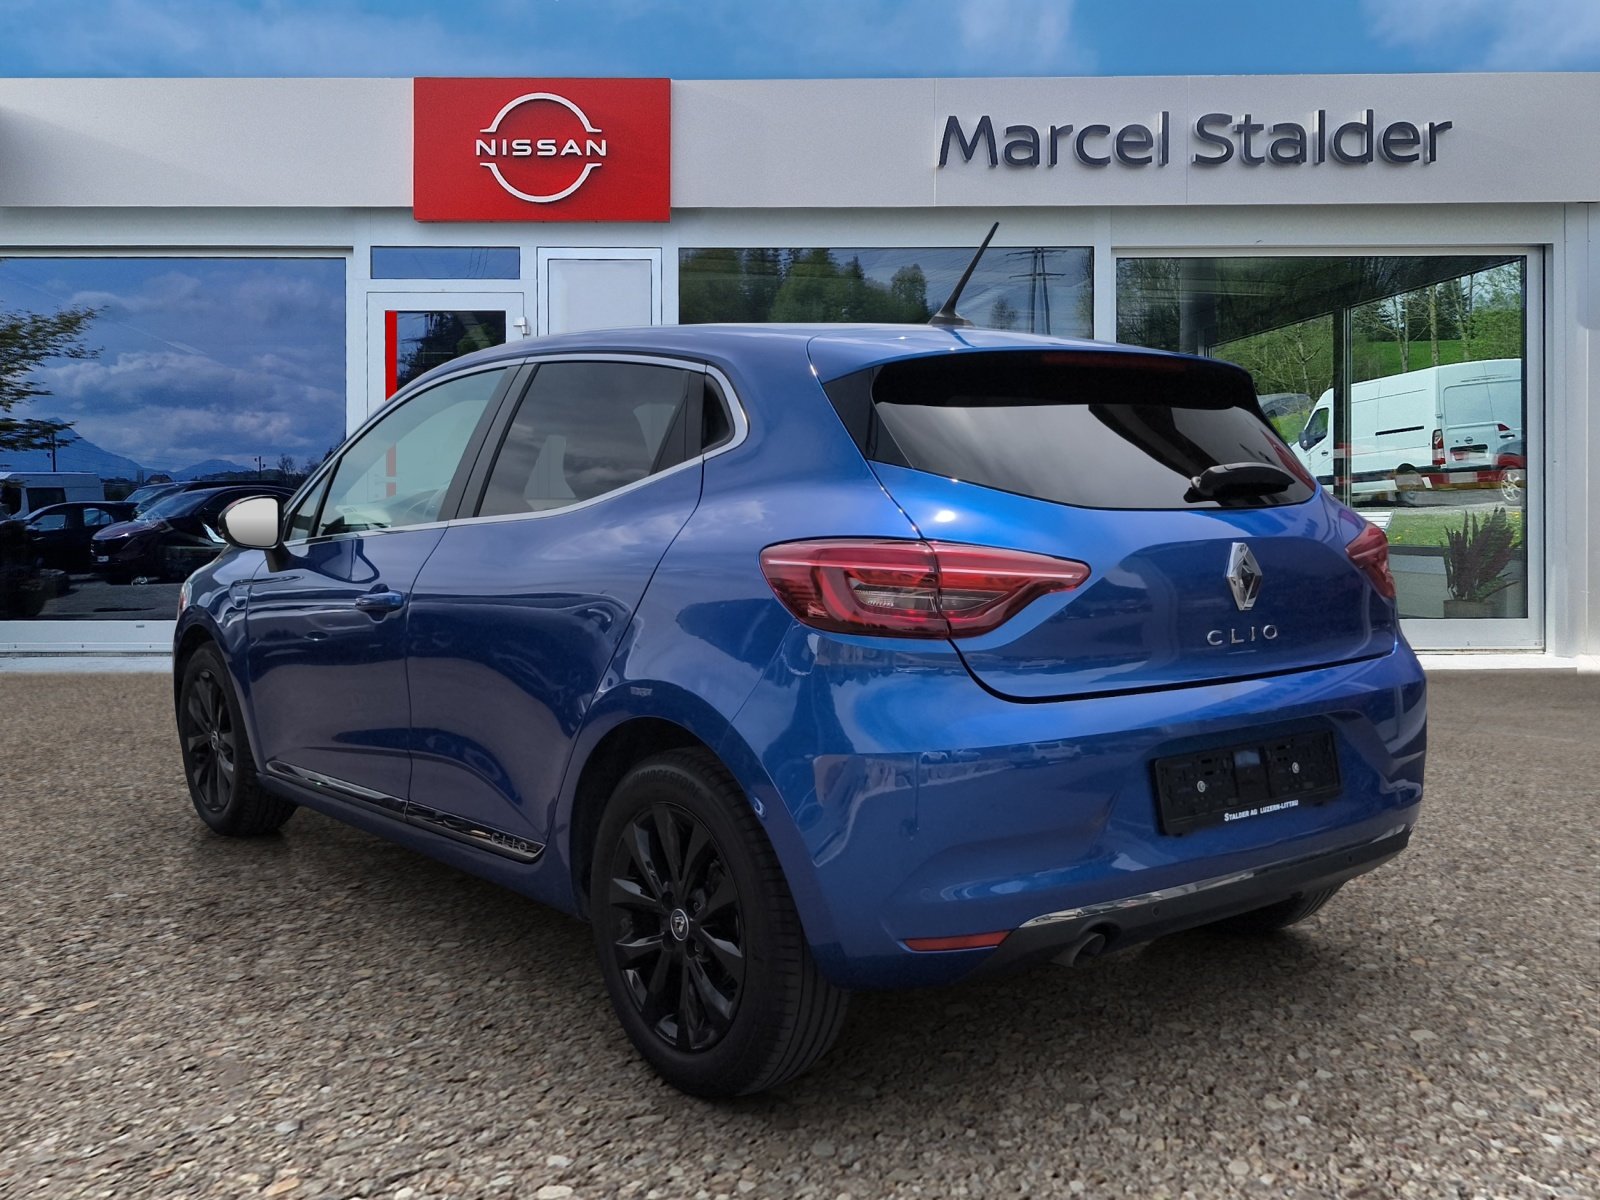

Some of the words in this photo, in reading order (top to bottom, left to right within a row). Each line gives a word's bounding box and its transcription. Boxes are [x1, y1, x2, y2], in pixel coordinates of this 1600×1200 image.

[475, 138, 607, 156] NISSAN
[938, 110, 1170, 168] Marcel
[1193, 108, 1453, 166] Stalder
[1206, 624, 1279, 646] CLIO
[1250, 808, 1258, 816] AG
[491, 832, 527, 851] CLIO
